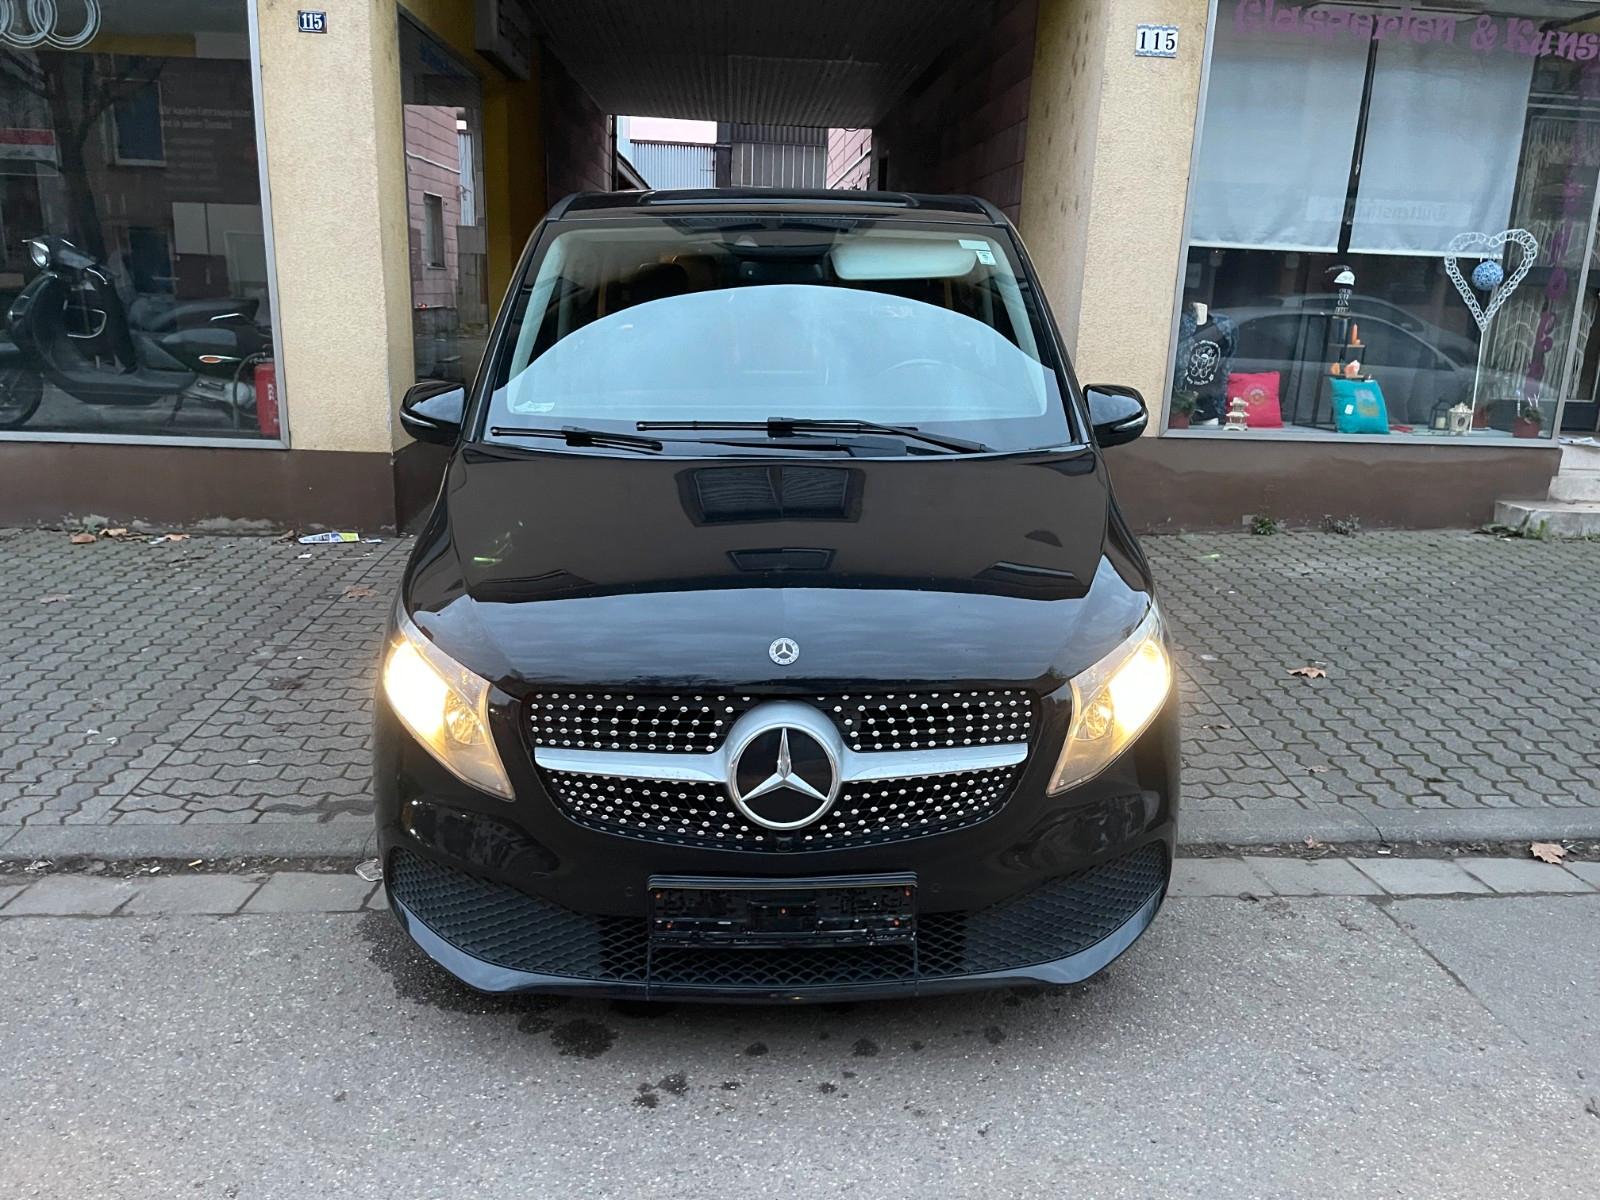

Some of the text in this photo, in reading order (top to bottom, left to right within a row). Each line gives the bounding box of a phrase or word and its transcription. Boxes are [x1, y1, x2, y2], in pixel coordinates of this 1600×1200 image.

[301, 13, 323, 30] 115
[1139, 30, 1176, 51] 115
[1470, 14, 1499, 51] &
[1503, 17, 1600, 61] Kuns
